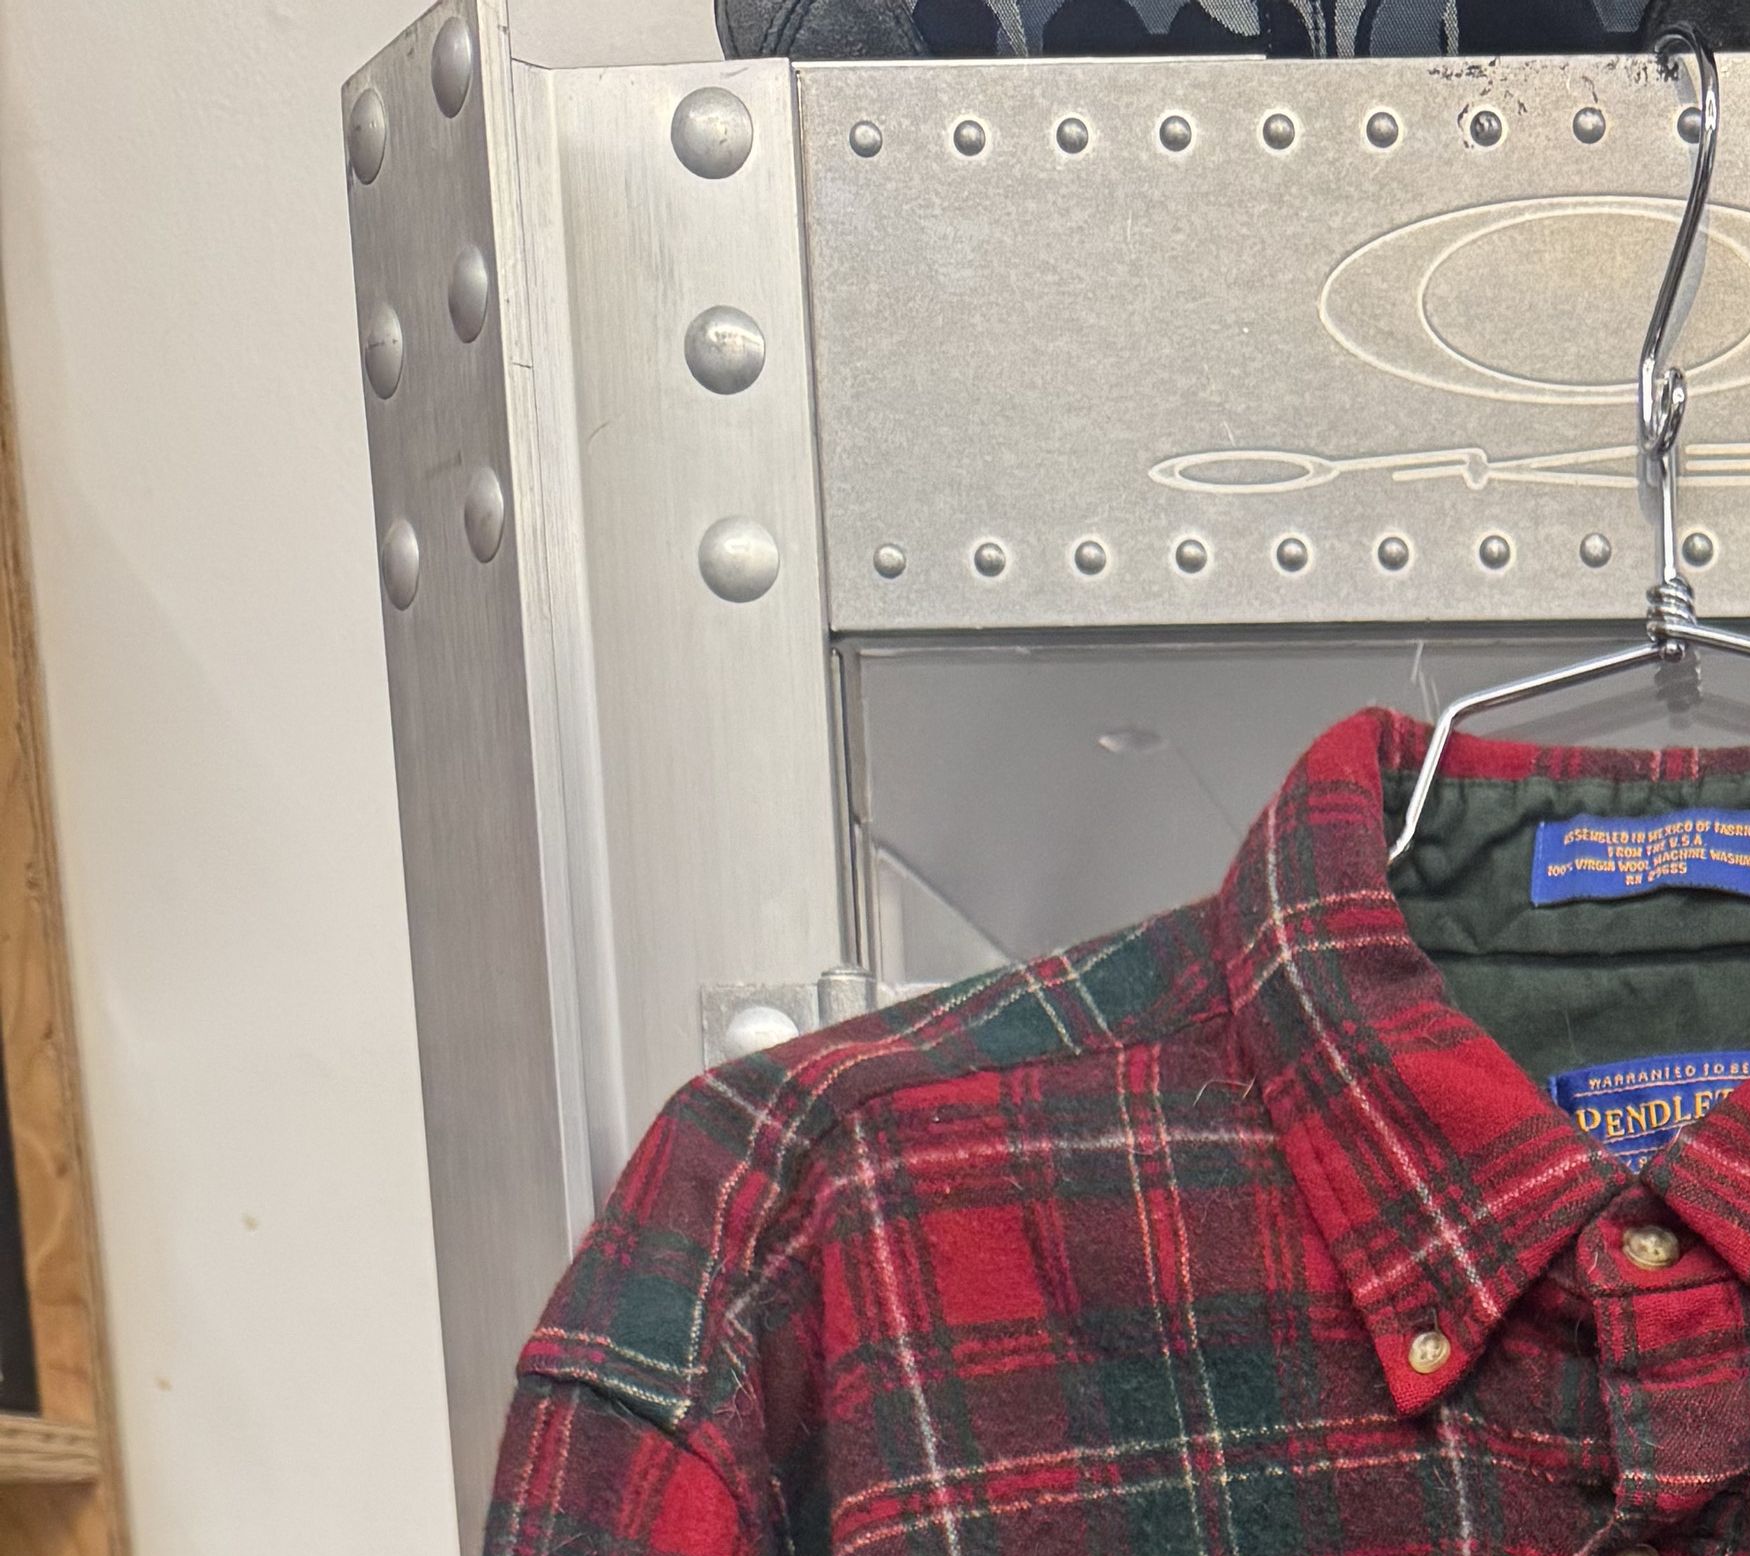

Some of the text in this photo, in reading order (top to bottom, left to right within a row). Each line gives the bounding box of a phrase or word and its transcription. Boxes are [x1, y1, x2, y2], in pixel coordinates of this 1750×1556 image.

[1564, 827, 1629, 845] ASSEMBLED
[1647, 820, 1693, 843] MEXICO
[1695, 819, 1711, 833] OF
[1575, 858, 1616, 873] VIRGIN
[1617, 860, 1652, 873] WOOL
[1653, 847, 1708, 867] MACHINE
[1607, 845, 1643, 858] FROM
[1588, 1064, 1696, 1091] WARRANTED
[1703, 1061, 1725, 1077] TO
[1730, 1061, 1750, 1075] BE
